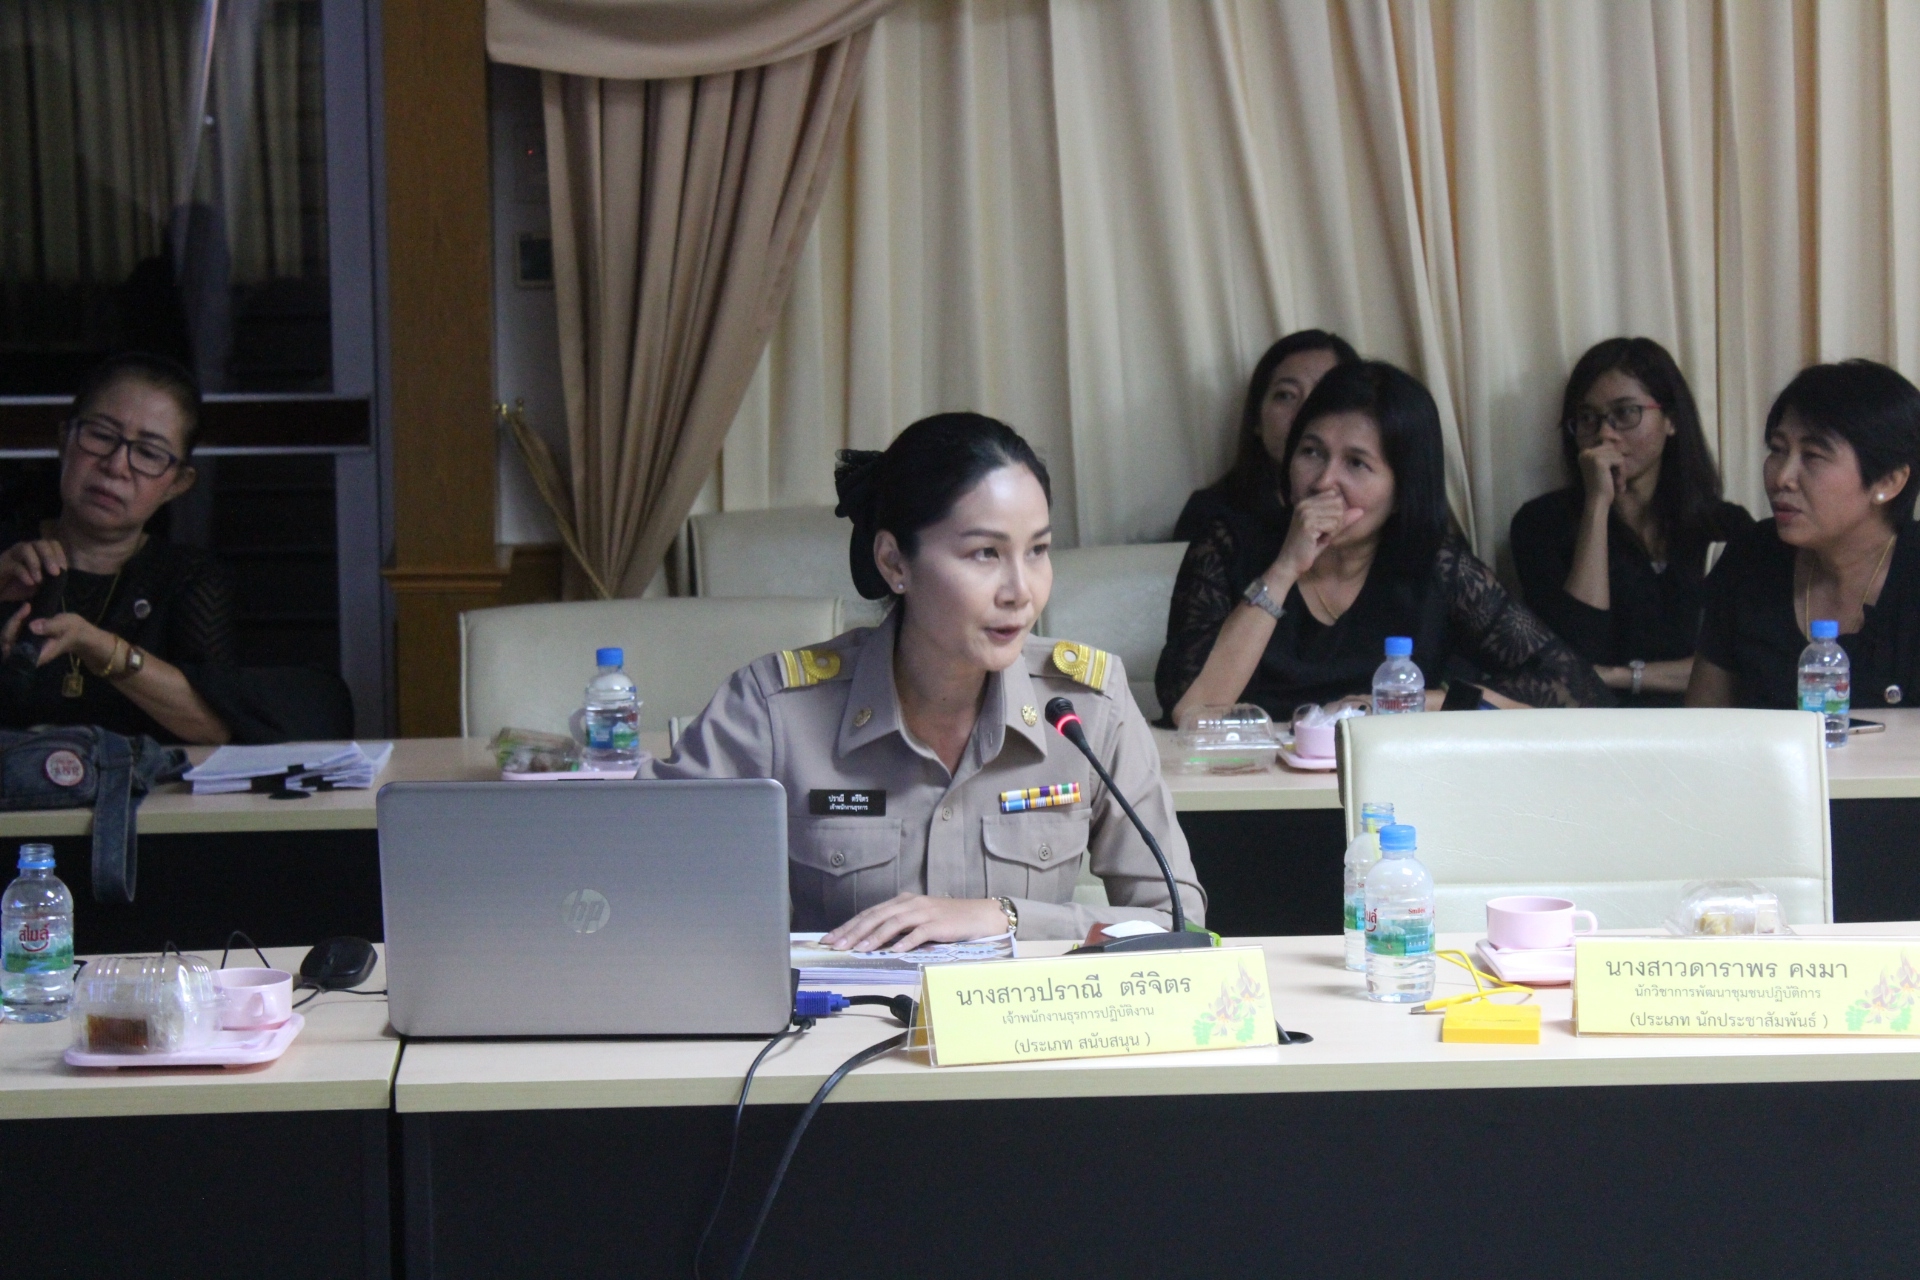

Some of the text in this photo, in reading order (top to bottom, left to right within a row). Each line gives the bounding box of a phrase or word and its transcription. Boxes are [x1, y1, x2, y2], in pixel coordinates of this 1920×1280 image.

[566, 888, 606, 934] hp
[18, 922, 50, 942] สไมล์
[1605, 959, 1849, 980] นางสาวดาราพร คงมา
[956, 970, 1192, 1006] นางสาวปราณี ตรีจิตร
[1629, 1012, 1691, 1029] (ประเภท
[1013, 1037, 1073, 1055] (ประเภท
